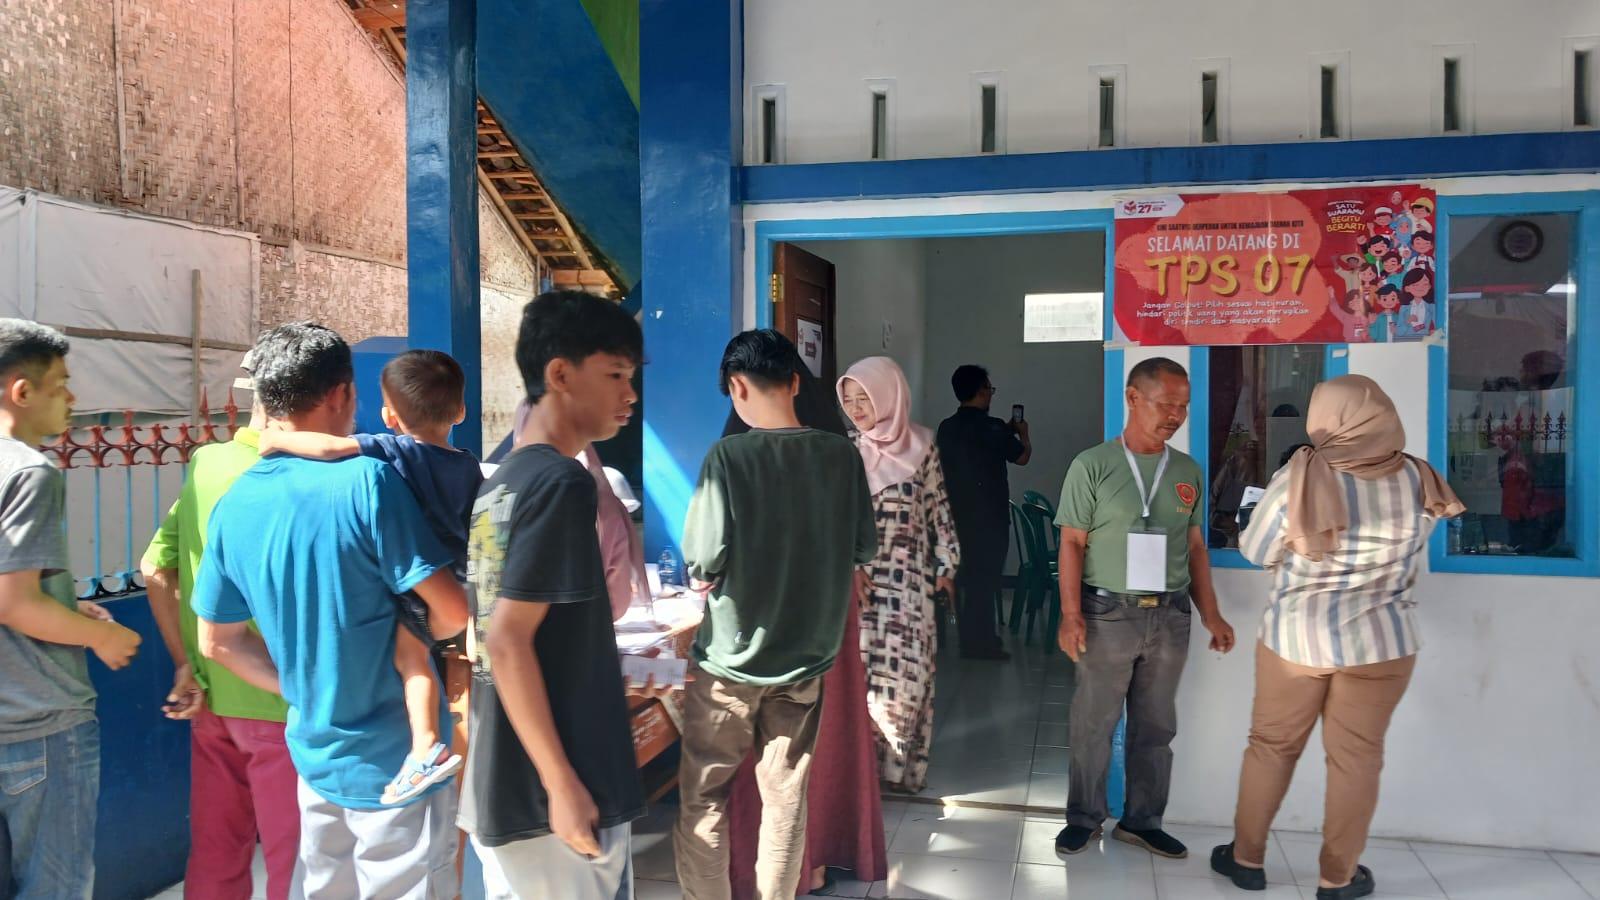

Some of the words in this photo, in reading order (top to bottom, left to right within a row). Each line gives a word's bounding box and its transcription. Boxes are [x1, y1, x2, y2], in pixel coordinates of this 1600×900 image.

[1138, 204, 1152, 213] 27
[1328, 208, 1364, 216] SUARAMU
[1327, 223, 1365, 232] BERARTI
[1147, 234, 1213, 252] SELAMAT
[1216, 233, 1278, 251] DATANG
[1282, 232, 1300, 249] DI
[1144, 254, 1239, 297] TPS
[1254, 253, 1312, 295] 07
[1142, 302, 1171, 310] Jangan
[1266, 308, 1310, 317] merugikan
[1229, 317, 1281, 325] masyarakat
